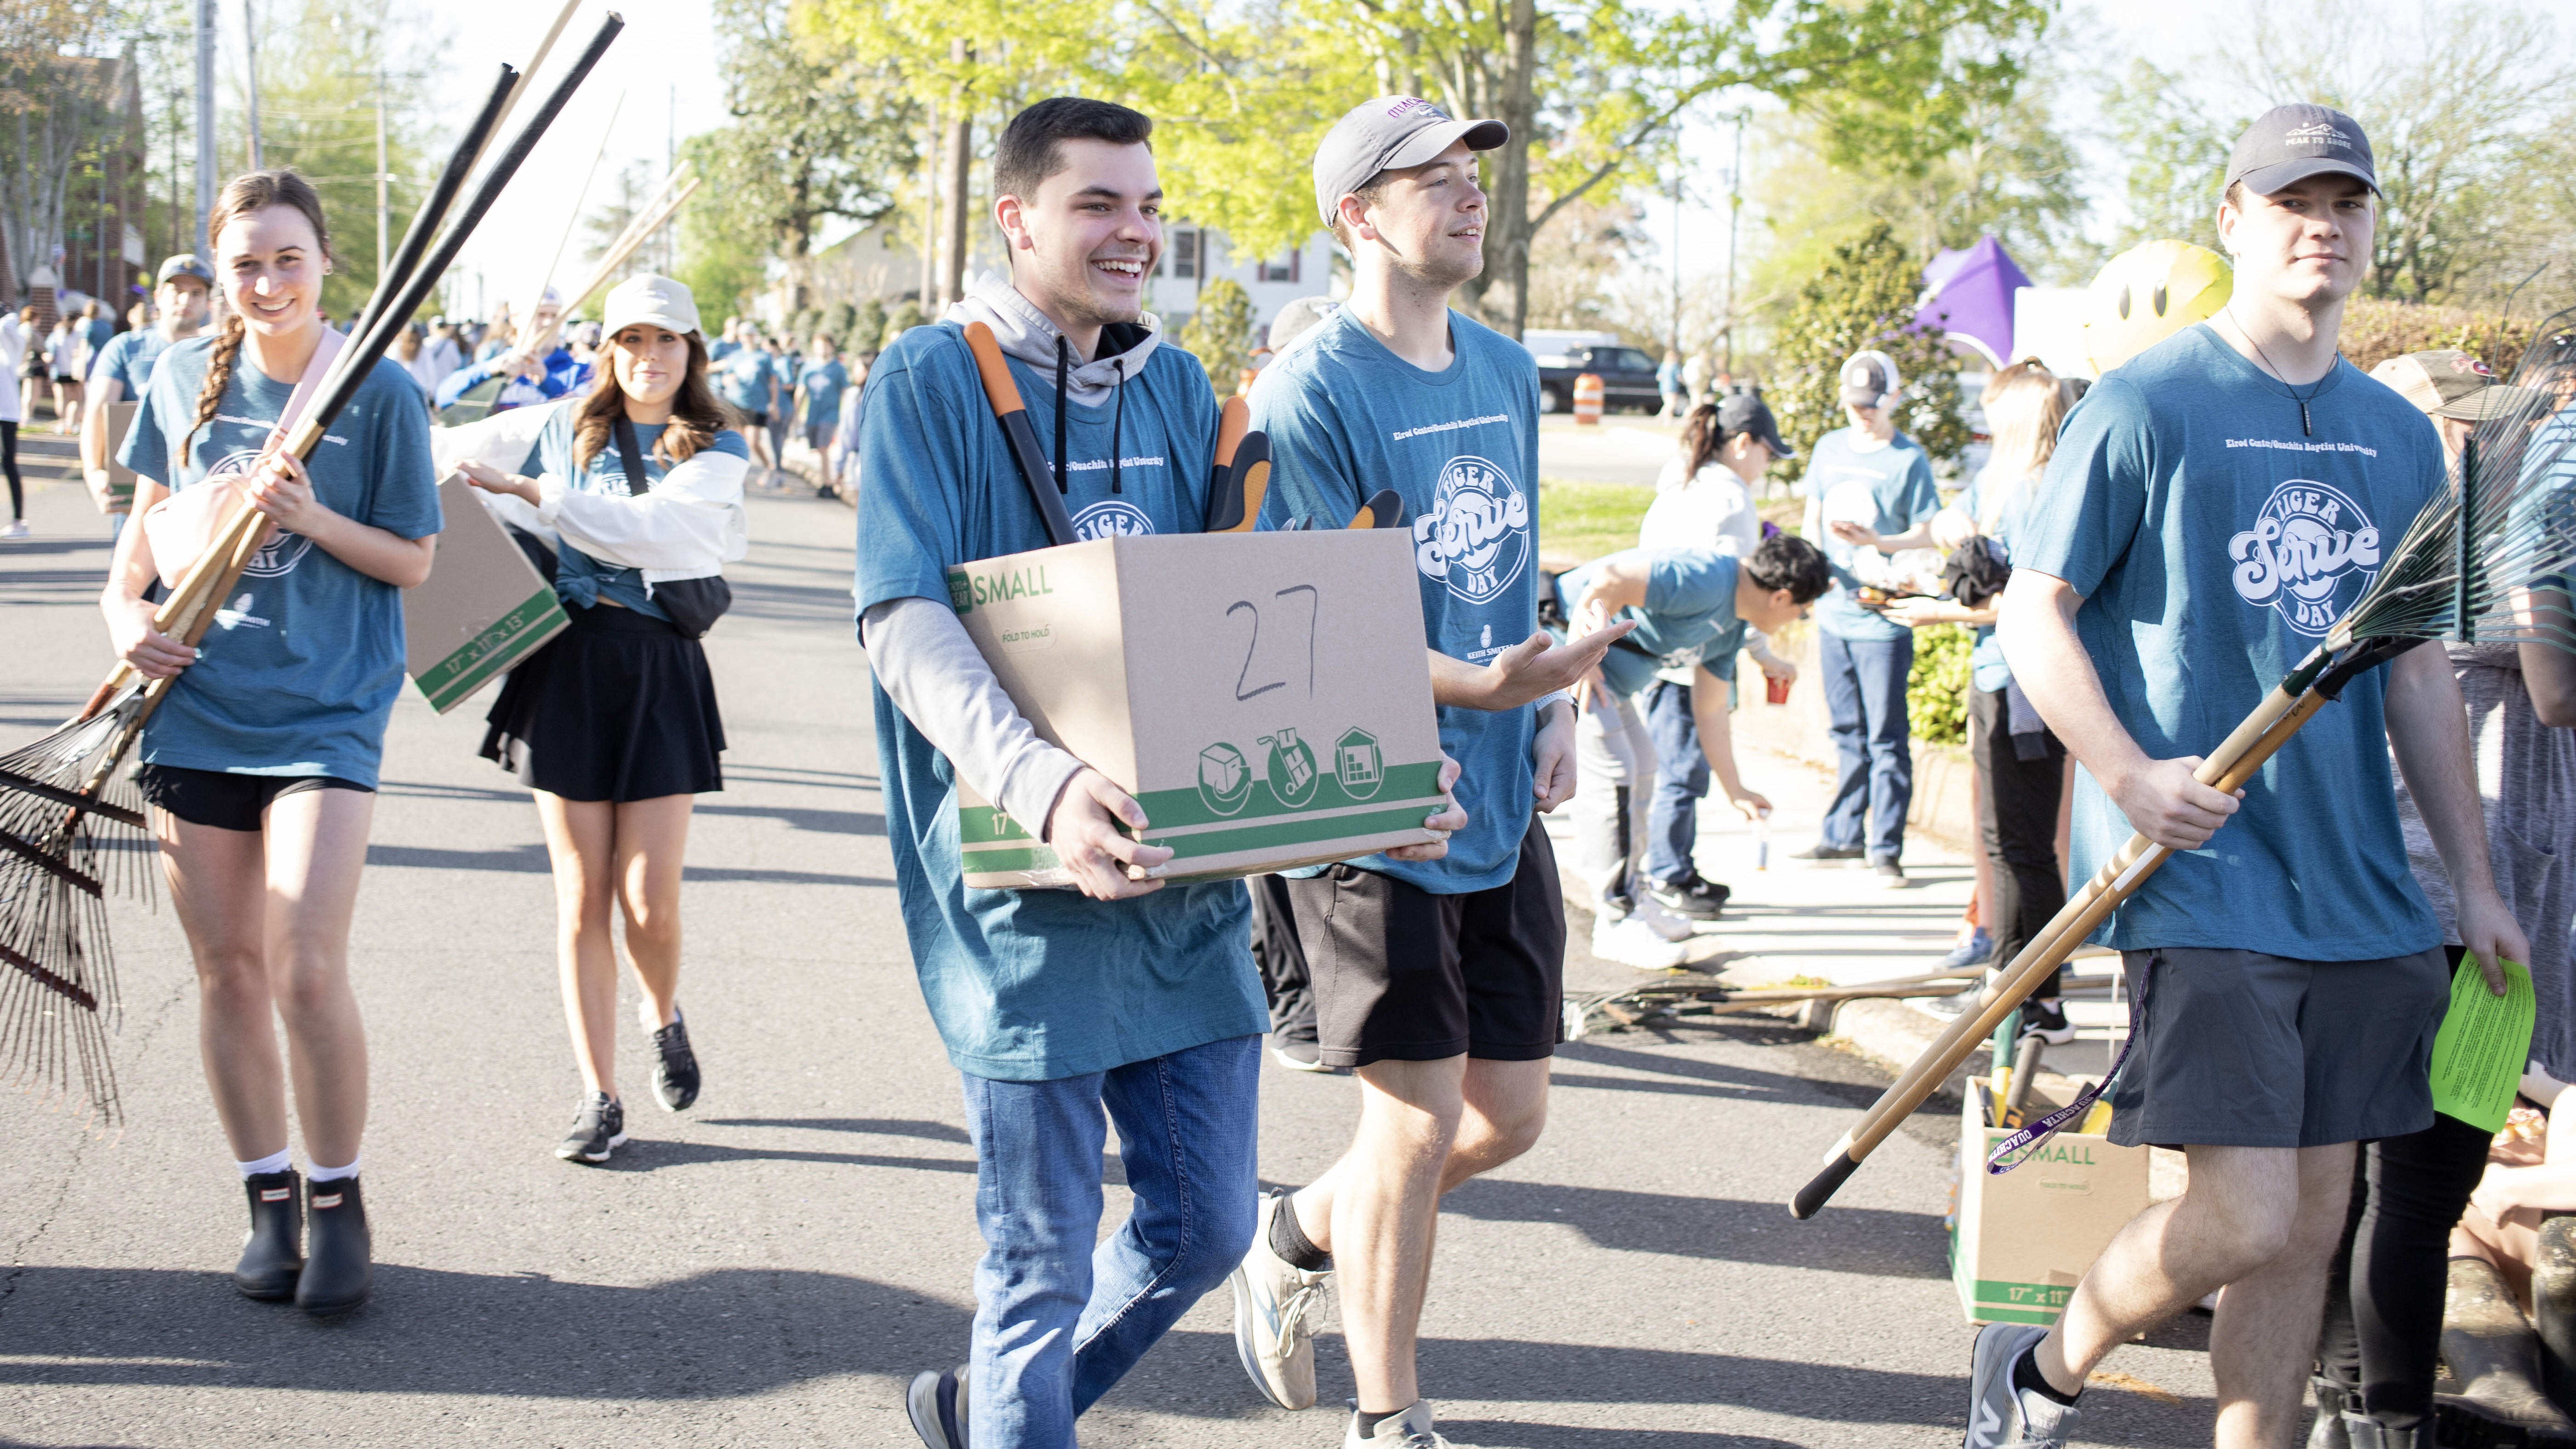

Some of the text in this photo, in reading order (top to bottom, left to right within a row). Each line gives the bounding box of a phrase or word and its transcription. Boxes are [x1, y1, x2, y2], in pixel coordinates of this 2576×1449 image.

[2285, 137, 2309, 146] PEAK
[1393, 429, 1413, 440] Elrod
[1457, 417, 1480, 428] Baptist
[1478, 414, 1508, 424] University
[2225, 439, 2248, 448] Elrod
[2304, 442, 2336, 452] Baptist
[1108, 458, 1134, 468] Bptist
[1443, 466, 1495, 500] TIGER
[2276, 491, 2340, 525] TIGER
[1413, 491, 1528, 577] Serve
[246, 551, 279, 568] AY
[2229, 518, 2380, 600] Serve
[974, 565, 1053, 605] SMALL
[1467, 566, 1499, 594] DAY
[2296, 600, 2336, 627] DAY
[1003, 628, 1050, 643] FOLD TO HOLD
[1226, 584, 1317, 701] 27
[1467, 649, 1486, 659] KEITH
[2042, 1096, 2094, 1127] OUACHITA
[2035, 1293, 2046, 1303] x
